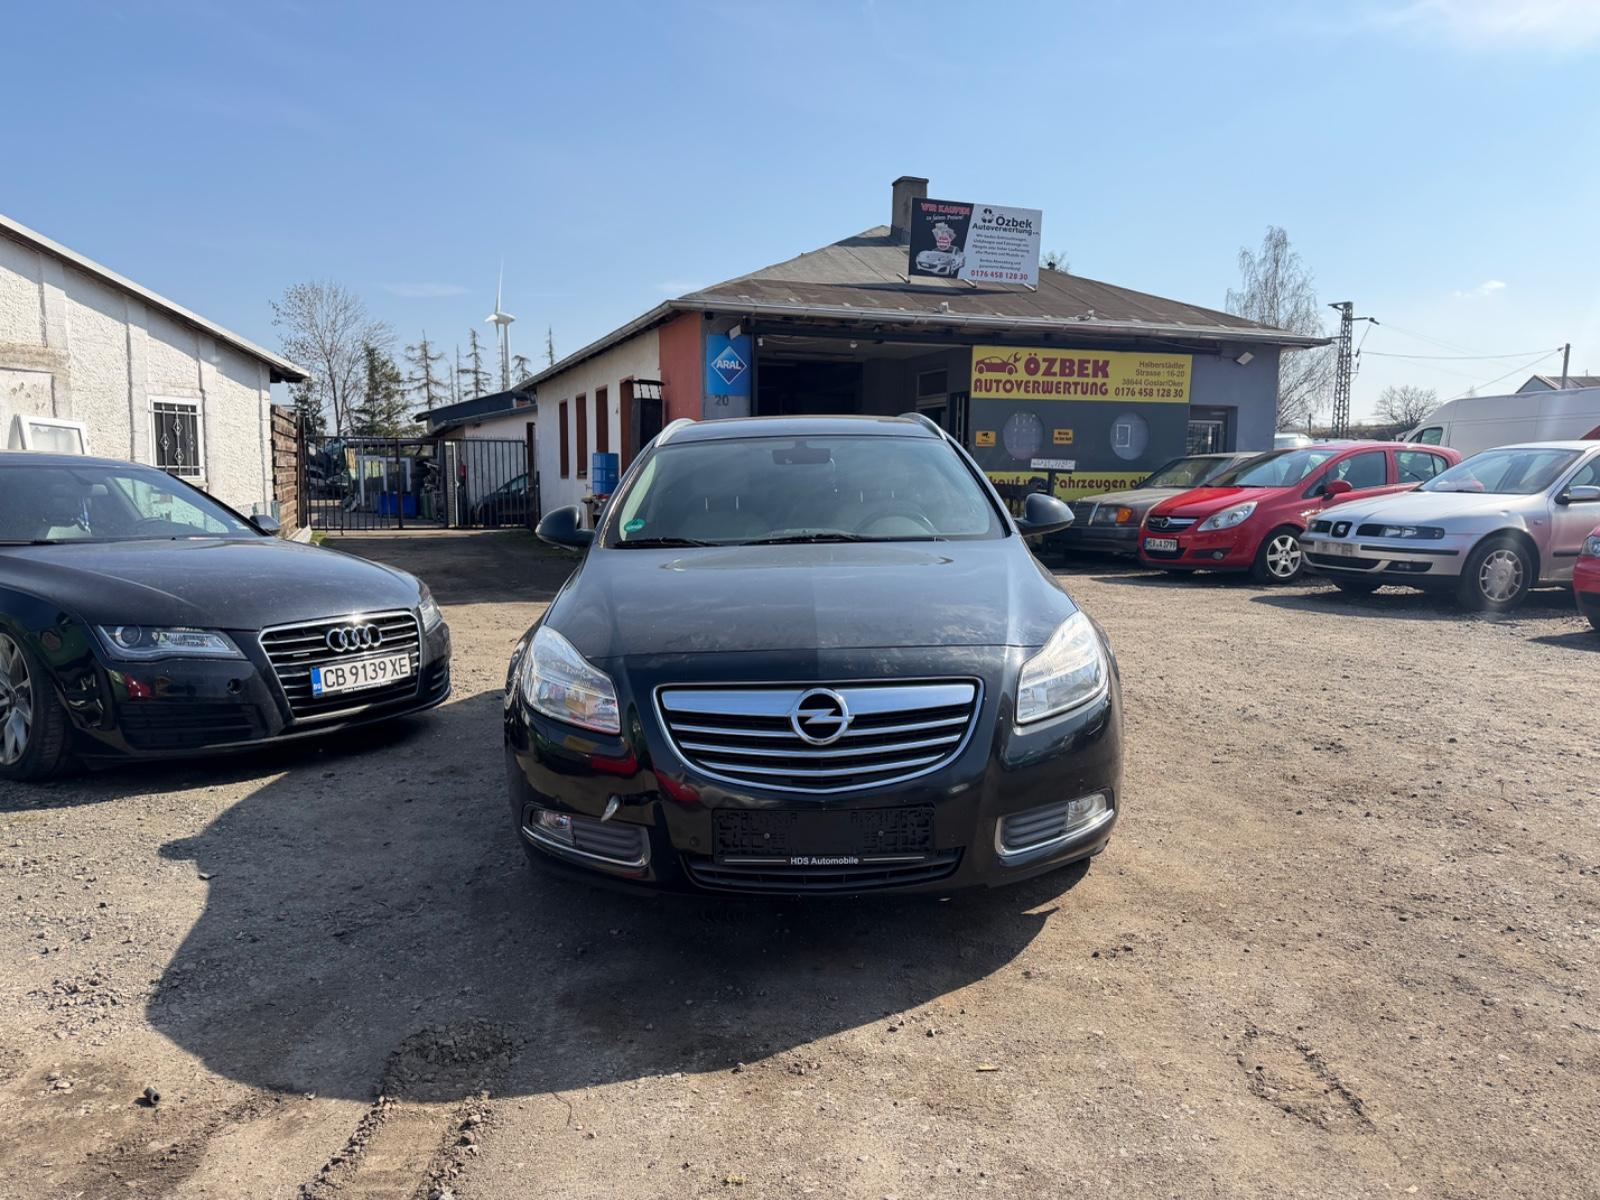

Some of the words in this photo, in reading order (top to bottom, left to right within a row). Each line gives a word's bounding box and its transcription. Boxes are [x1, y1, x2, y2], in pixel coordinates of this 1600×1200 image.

[995, 213, 1033, 229] Özbek
[972, 222, 1033, 236] Autoverwertung
[971, 270, 988, 278] 0176
[991, 271, 1004, 279] 458
[1006, 272, 1018, 280] 128
[1019, 273, 1029, 281] 30
[716, 359, 741, 370] ARAL
[1024, 352, 1110, 379] ÖZBEK
[973, 378, 1109, 396] AUTOVERWERTUNG
[1114, 386, 1136, 397] 0176
[1138, 387, 1154, 397] 458
[1156, 388, 1171, 398] 128
[1172, 388, 1184, 398] 30
[714, 395, 729, 407] 20
[323, 668, 347, 689] CB
[349, 660, 388, 684] 9139
[389, 657, 409, 677] XE
[790, 856, 809, 865] HDS
[810, 856, 859, 865] Automobile
